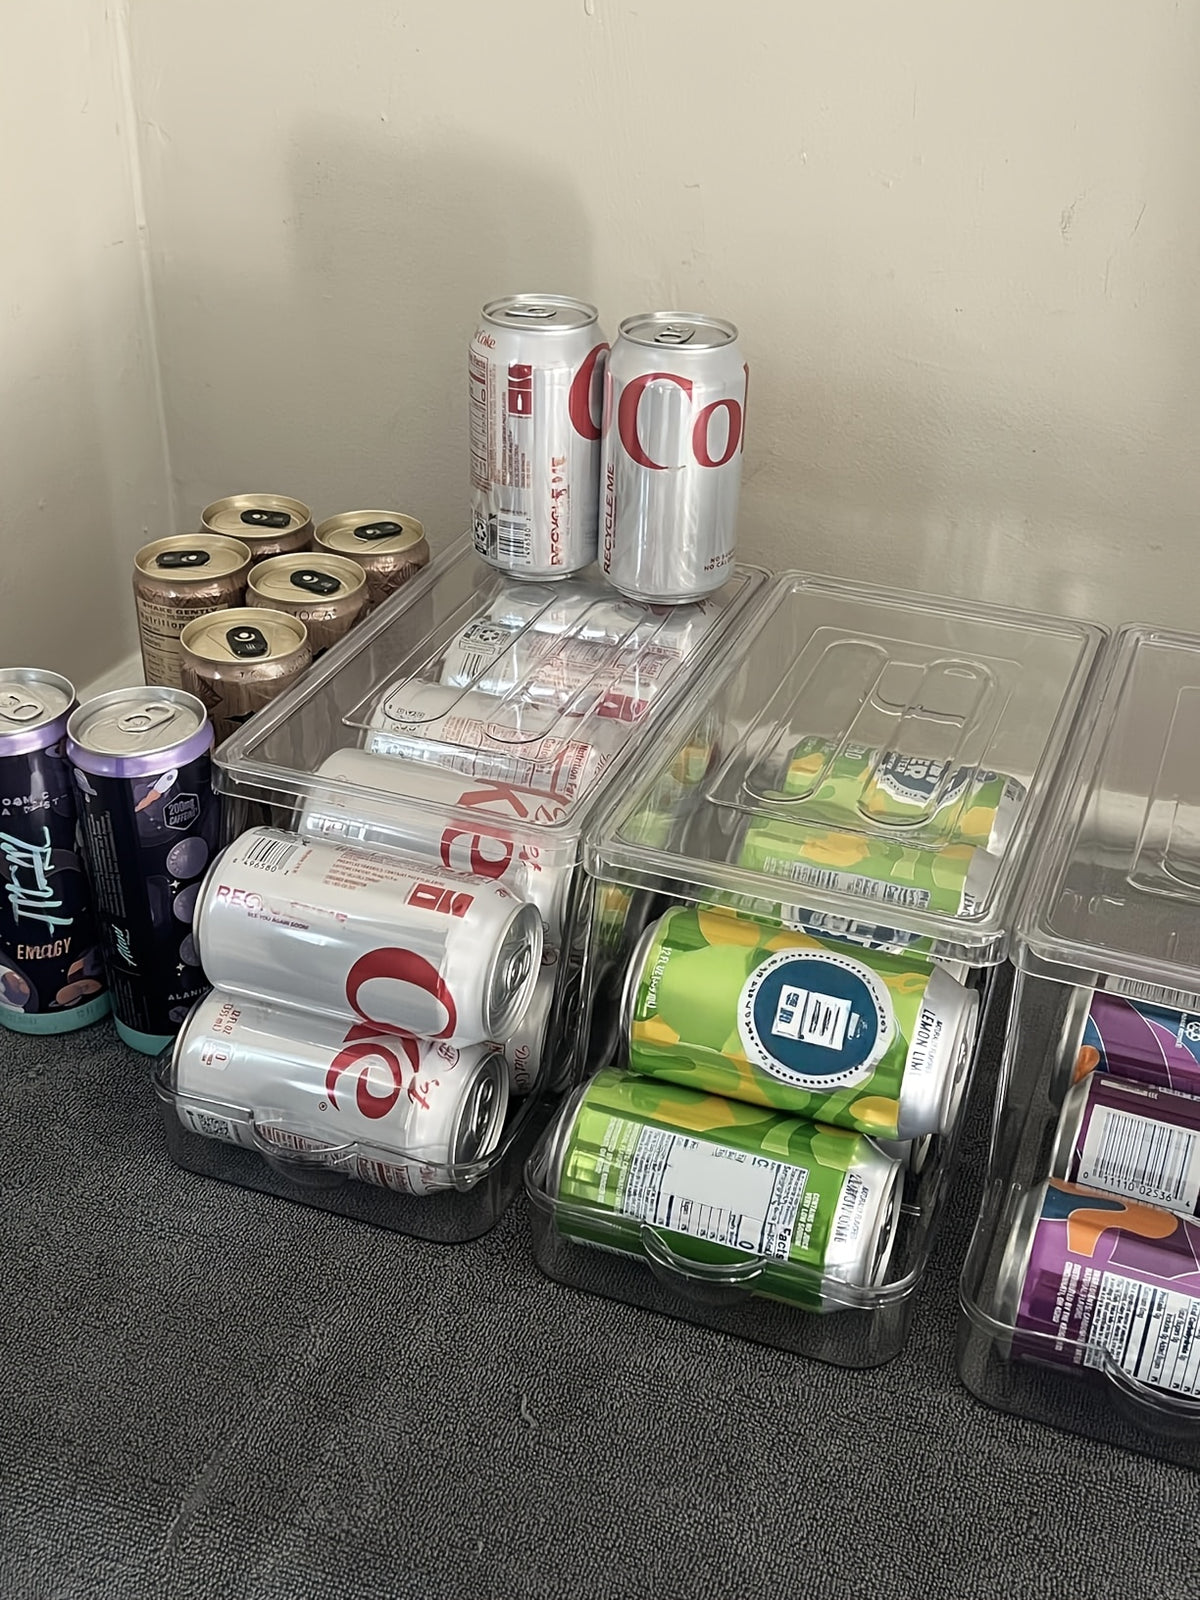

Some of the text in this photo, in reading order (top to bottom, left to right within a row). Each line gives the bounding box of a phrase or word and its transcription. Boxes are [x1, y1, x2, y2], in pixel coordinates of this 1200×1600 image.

[618, 361, 750, 470] Co
[607, 463, 615, 492] ME
[603, 495, 614, 574] RECYCLE
[175, 607, 218, 615] GENTLY
[916, 1008, 936, 1047] LEMON
[909, 1051, 926, 1075] LIM
[803, 1192, 812, 1208] VERY
[1083, 1171, 1089, 1179] 0
[1104, 1175, 1135, 1191] 11110
[1139, 1185, 1172, 1202] 02536
[800, 1208, 809, 1223] LOW
[808, 1193, 820, 1223] CONTAINS
